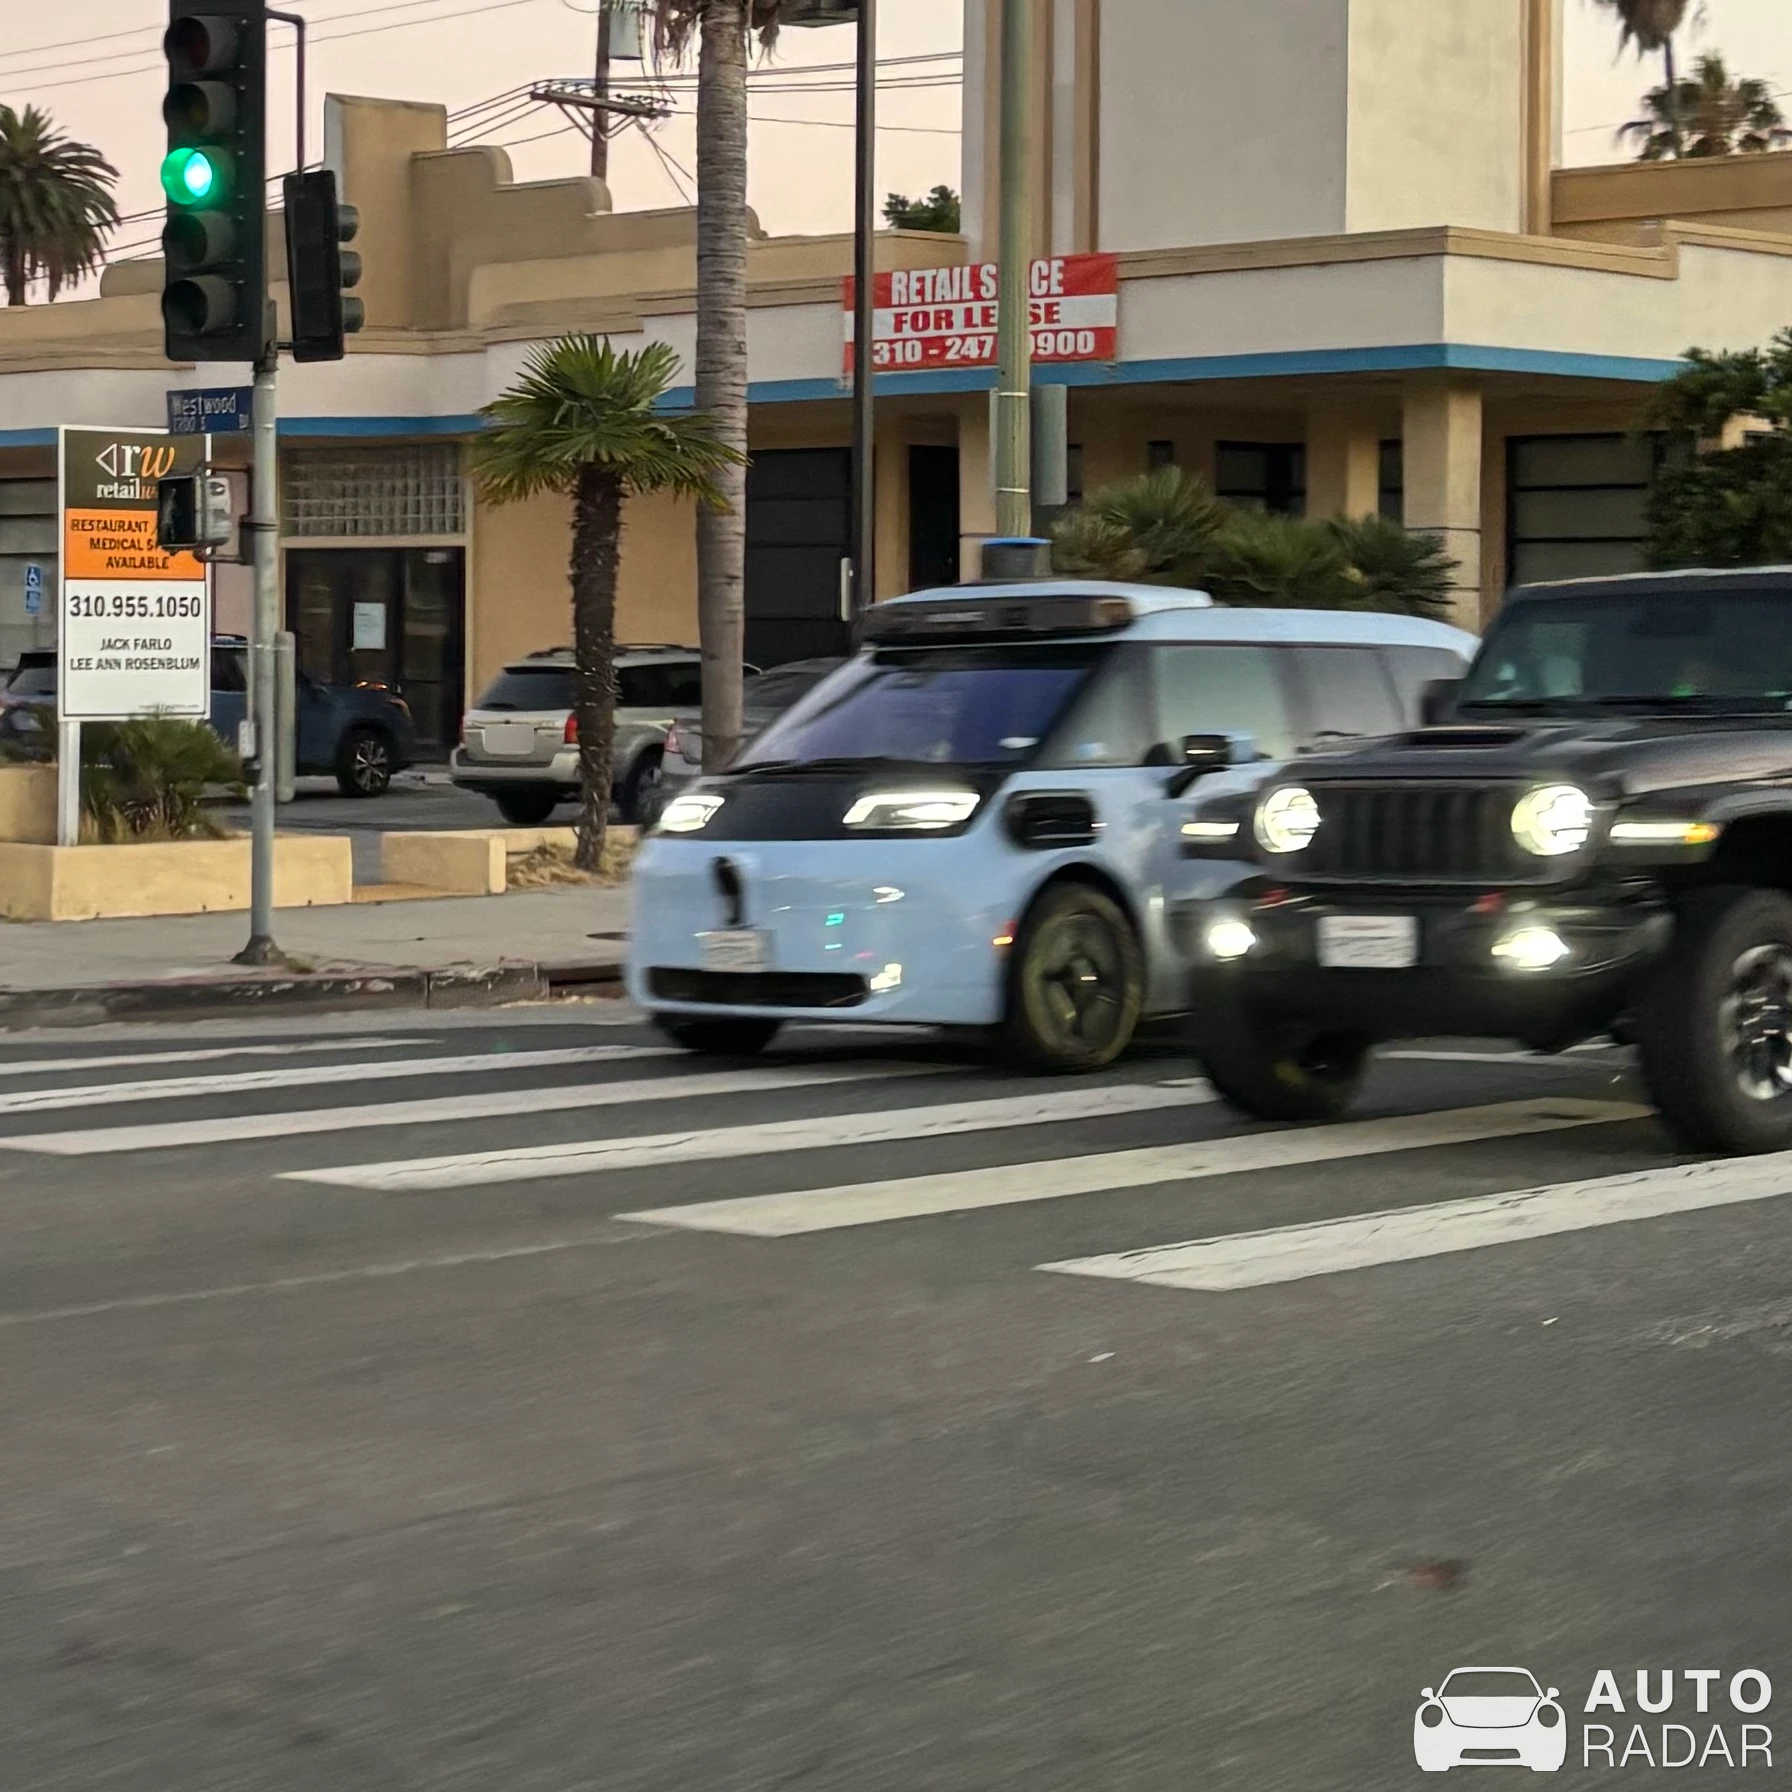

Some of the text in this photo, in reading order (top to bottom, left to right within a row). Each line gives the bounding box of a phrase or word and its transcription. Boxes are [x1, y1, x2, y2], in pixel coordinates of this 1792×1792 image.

[891, 259, 1065, 305] RETAIL SCE
[893, 301, 1061, 334] FOR LESE
[872, 340, 922, 364] 310
[945, 335, 994, 360] 247
[172, 392, 236, 415] Westwood
[121, 443, 175, 477] rw
[71, 518, 149, 533] RESTAURANT
[90, 537, 143, 551] MEDICAL
[106, 556, 169, 570] AVAILABLE
[69, 595, 200, 618] 310.955.1050
[100, 638, 172, 651] JACK FARLO
[70, 656, 200, 671] LEE ANN ROSENBLUM
